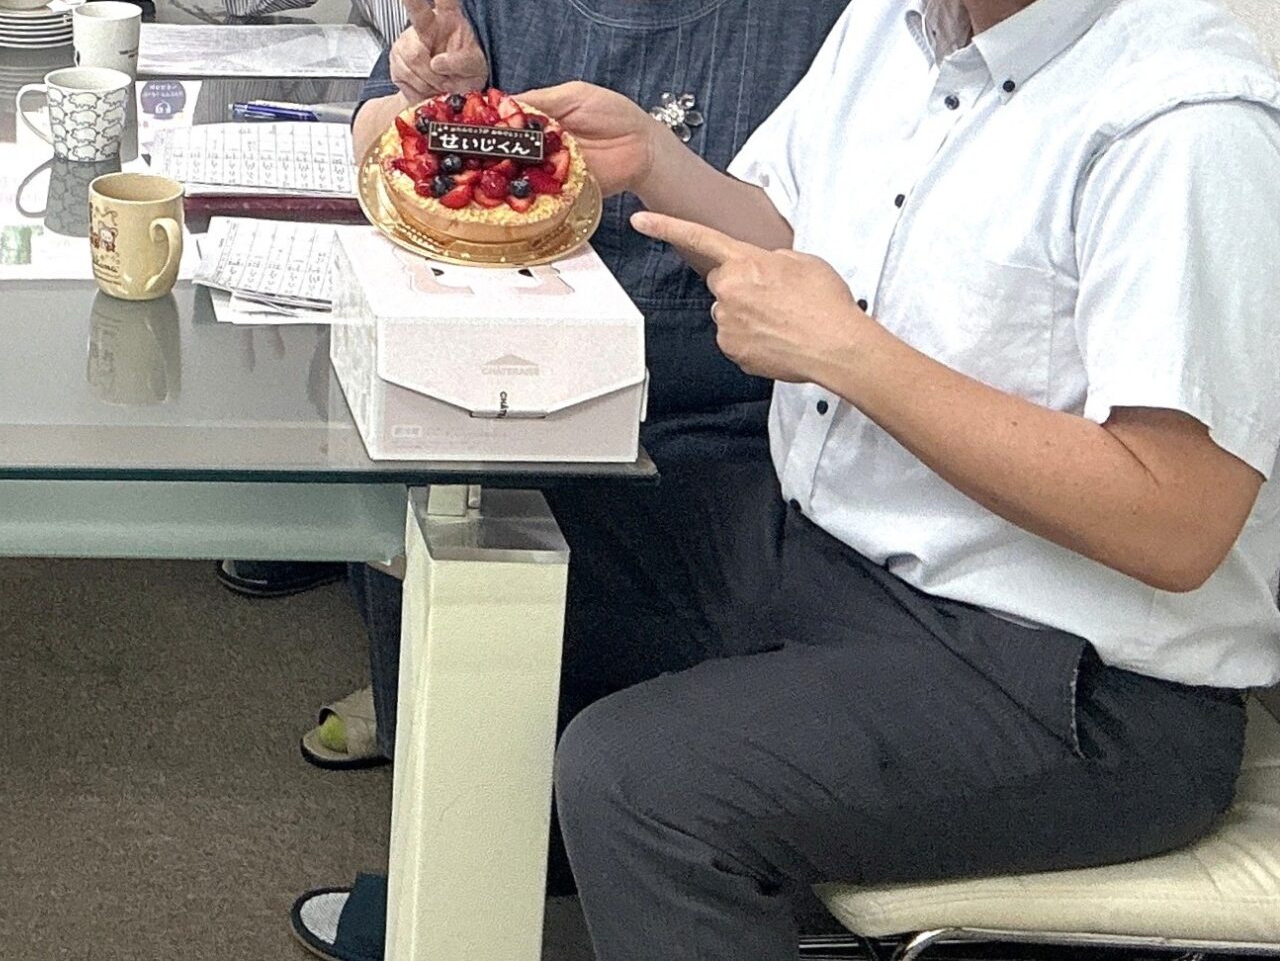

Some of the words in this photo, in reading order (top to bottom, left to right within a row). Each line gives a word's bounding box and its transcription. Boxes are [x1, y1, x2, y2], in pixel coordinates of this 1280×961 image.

[439, 134, 530, 155] せいじくん
